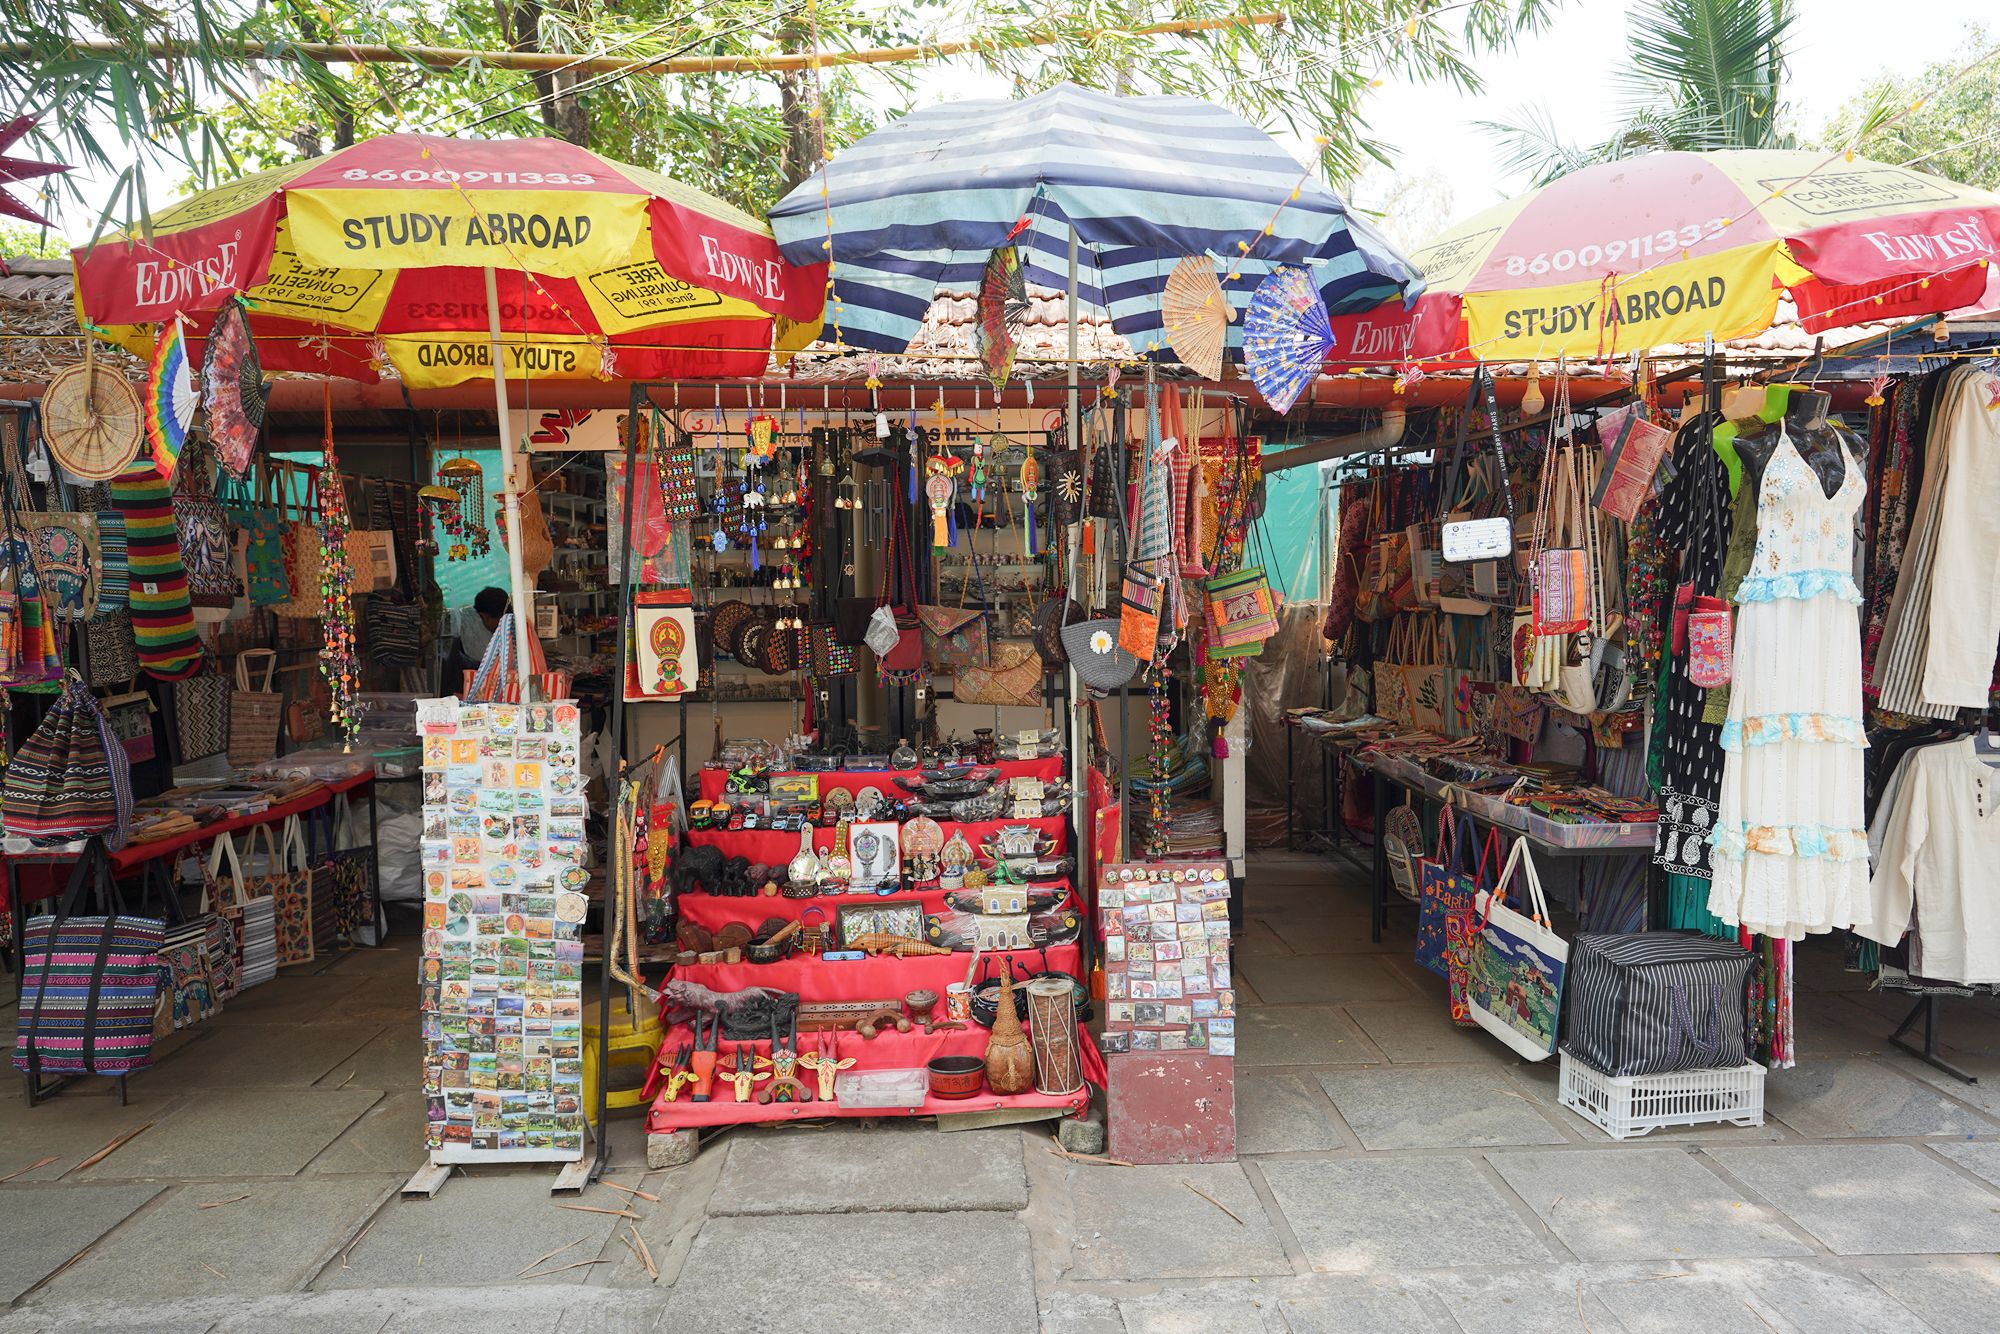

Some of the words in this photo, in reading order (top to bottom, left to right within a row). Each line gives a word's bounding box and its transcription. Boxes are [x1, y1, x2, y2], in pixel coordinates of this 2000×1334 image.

[342, 169, 596, 186] 8600911333
[1793, 182, 1925, 202] COUNSELING
[1875, 192, 1914, 205] 1991
[342, 212, 452, 250] STUDY
[465, 212, 592, 249] ABROAD
[1505, 217, 1729, 276] 8600911333
[135, 240, 239, 306] EDWISE
[1504, 301, 1596, 339] STUDY
[1605, 276, 1726, 328] ABROAD
[1490, 410, 1498, 432] PARIS
[1494, 432, 1508, 472] LUSHBERRY
